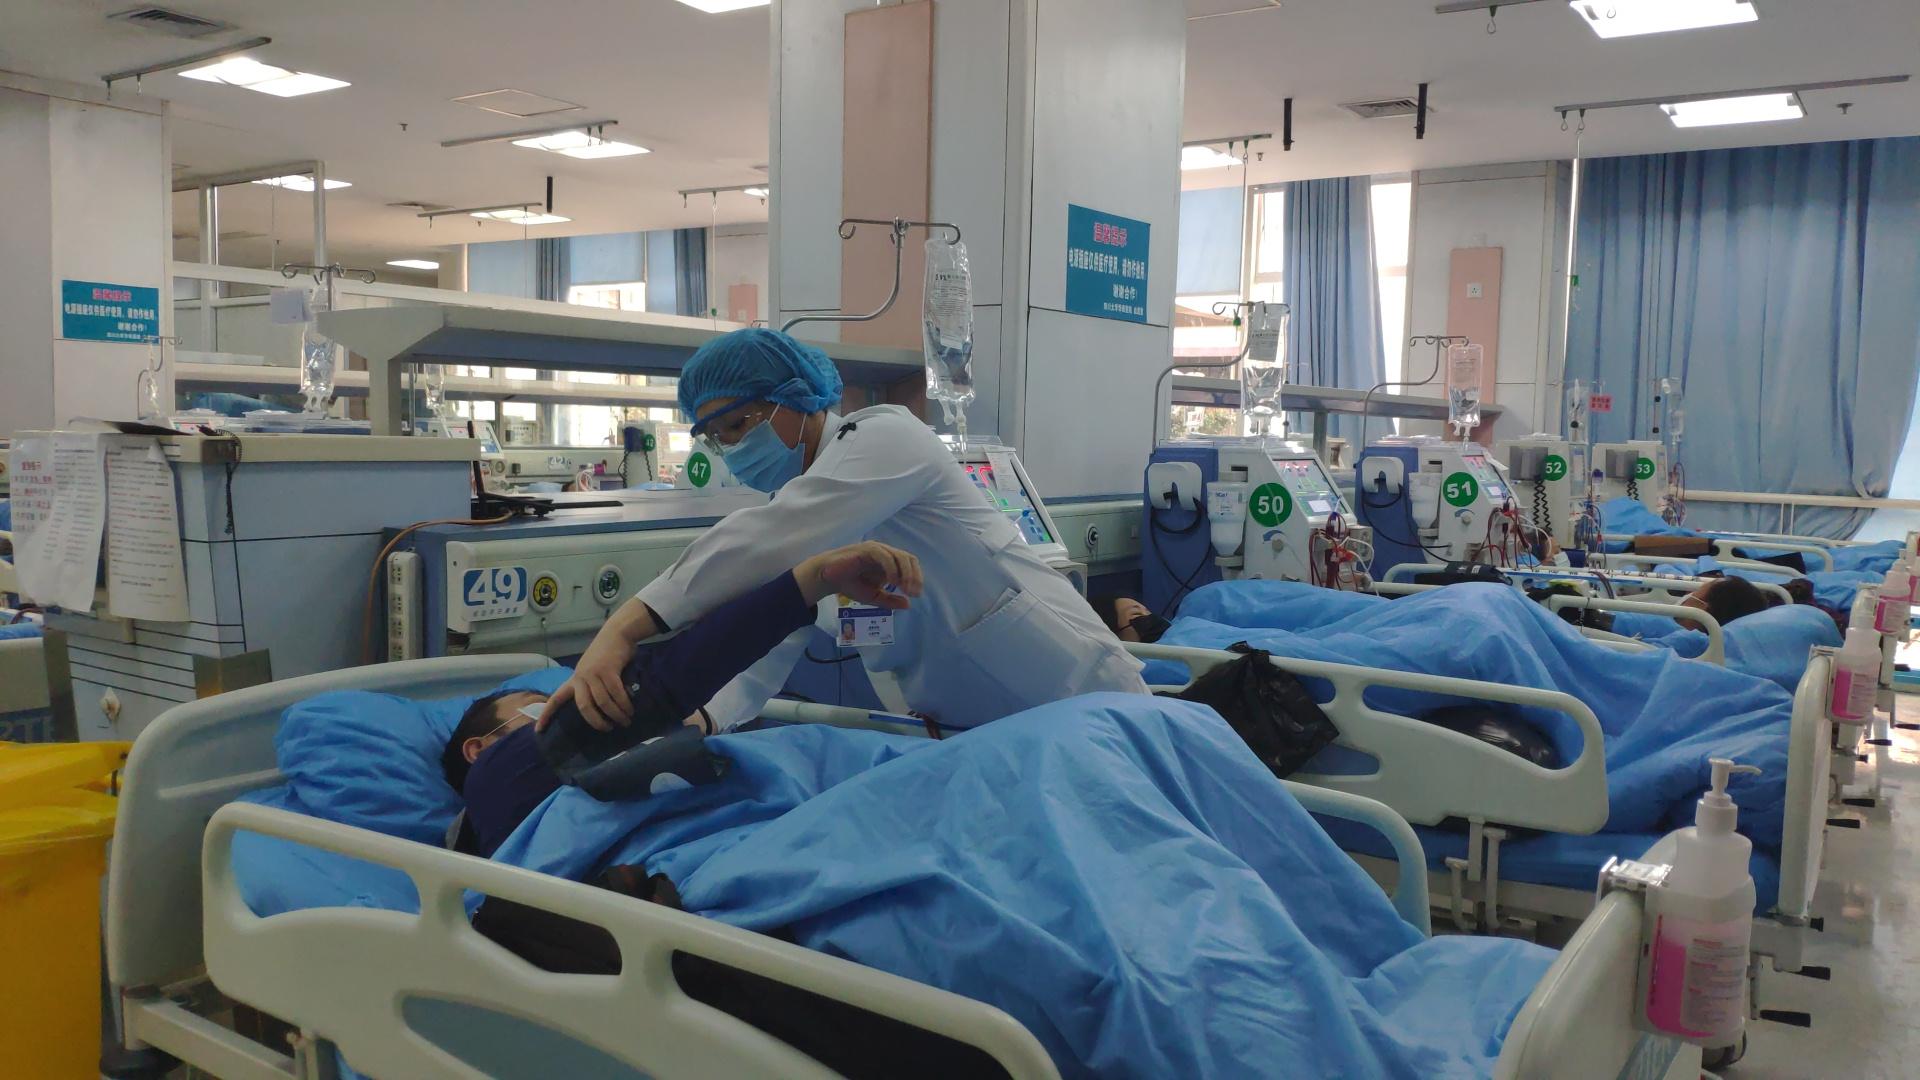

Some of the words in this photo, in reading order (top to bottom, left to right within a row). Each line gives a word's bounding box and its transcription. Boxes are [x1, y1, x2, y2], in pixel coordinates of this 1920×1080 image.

[691, 461, 707, 478] 47
[1545, 462, 1562, 474] 52
[1636, 464, 1651, 474] 53
[1446, 481, 1472, 499] 51
[1257, 495, 1284, 515] 50
[468, 567, 521, 606] 49
